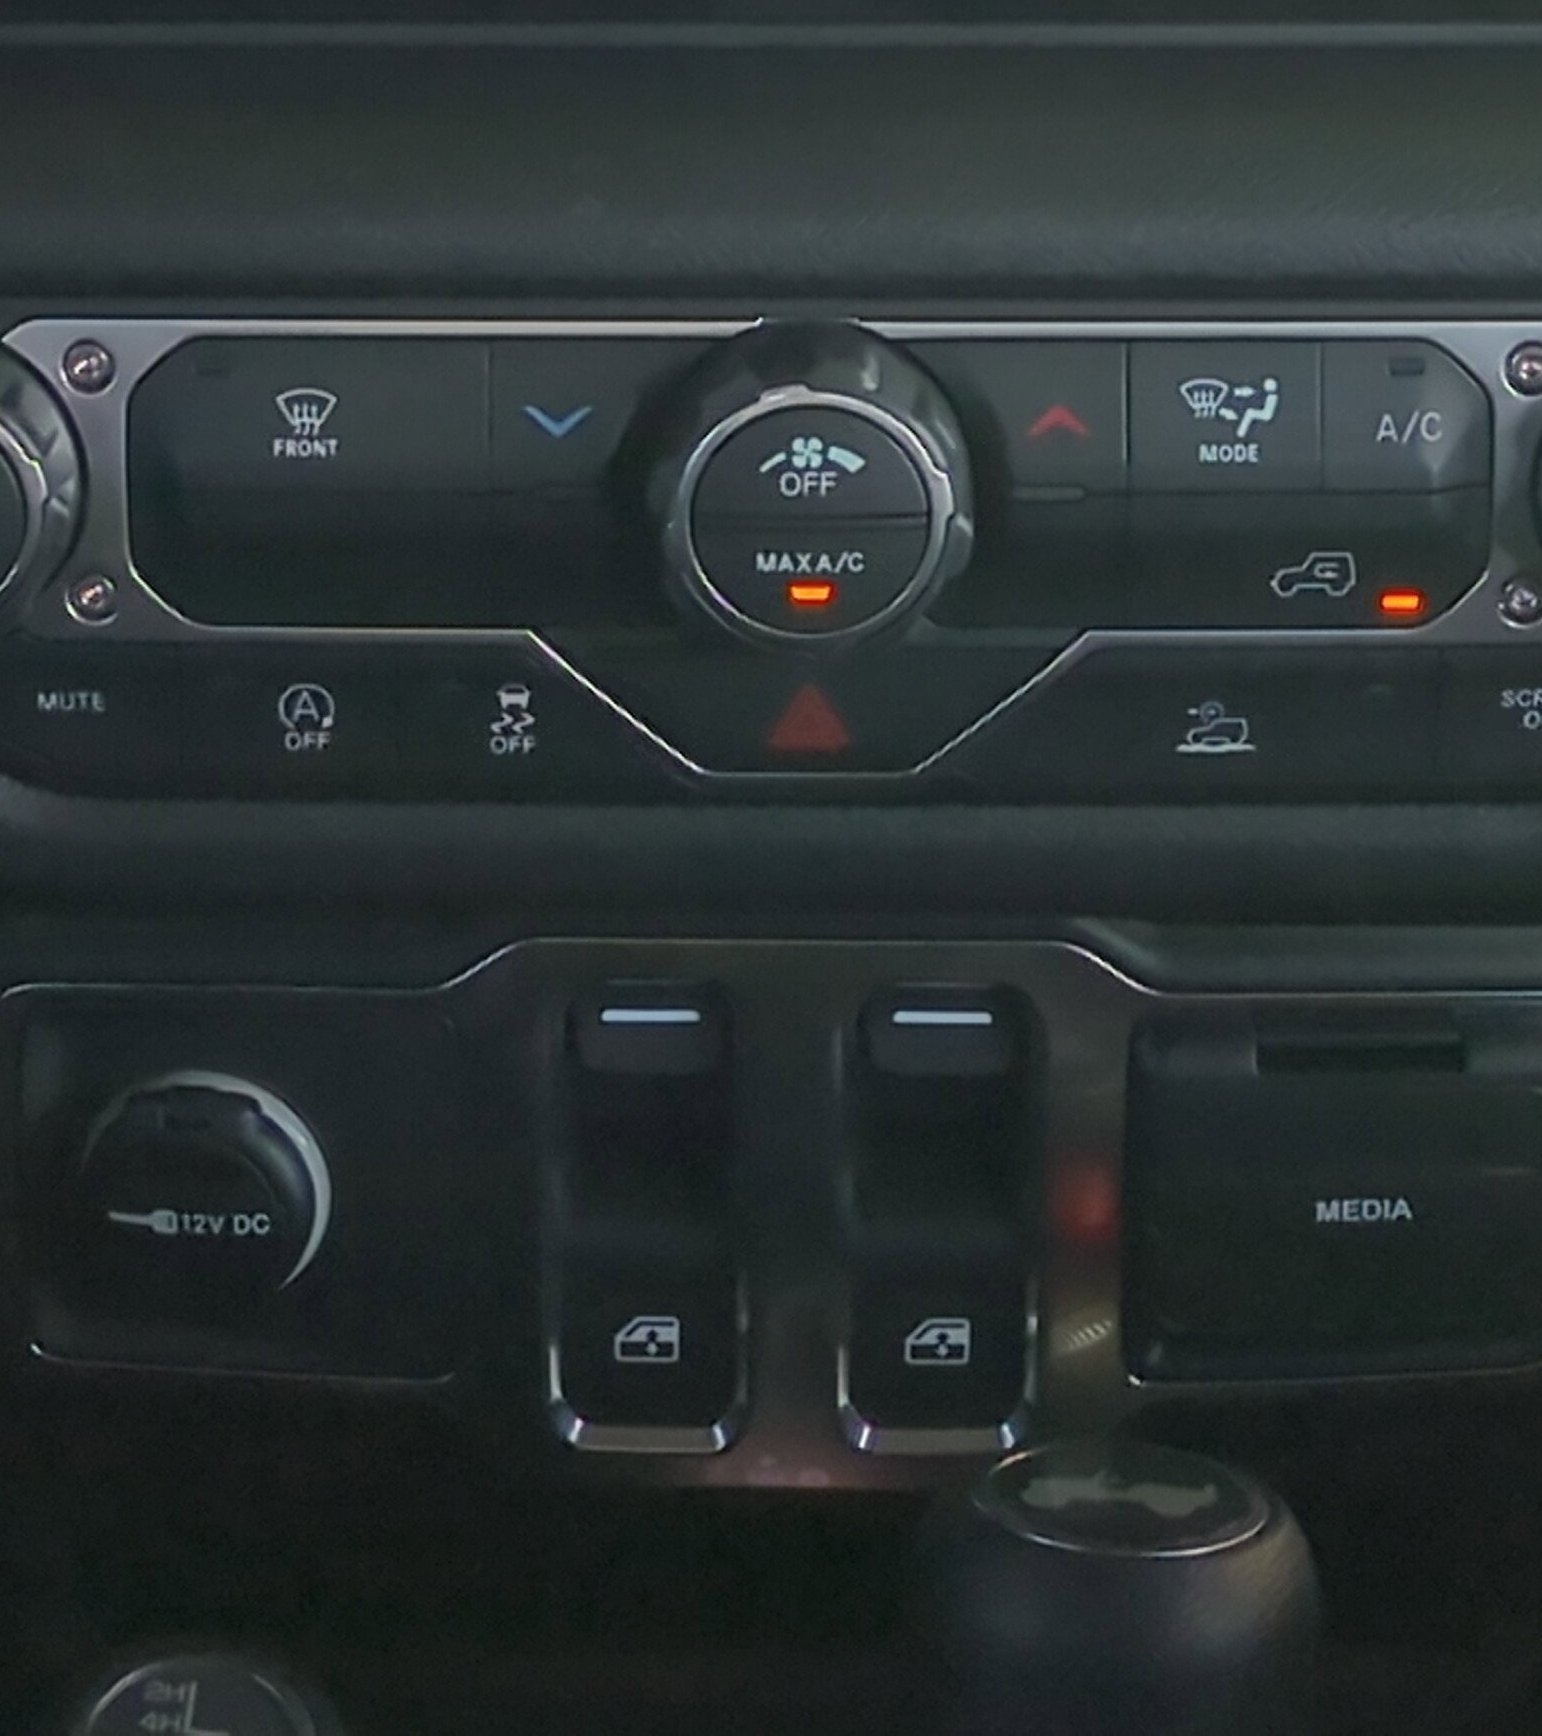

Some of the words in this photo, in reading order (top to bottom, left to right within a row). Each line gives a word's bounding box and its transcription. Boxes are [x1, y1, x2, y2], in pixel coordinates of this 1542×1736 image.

[1375, 411, 1444, 443] A/C
[273, 438, 340, 458] FRONT
[1198, 442, 1260, 463] MODE
[779, 471, 838, 497] OFF
[755, 552, 812, 572] MAX
[36, 690, 106, 712] MUTE
[283, 729, 332, 751] OFF
[489, 734, 537, 755] OFF
[1314, 1196, 1413, 1224] MEDIA
[179, 1213, 226, 1236] 12V
[232, 1211, 271, 1236] DC
